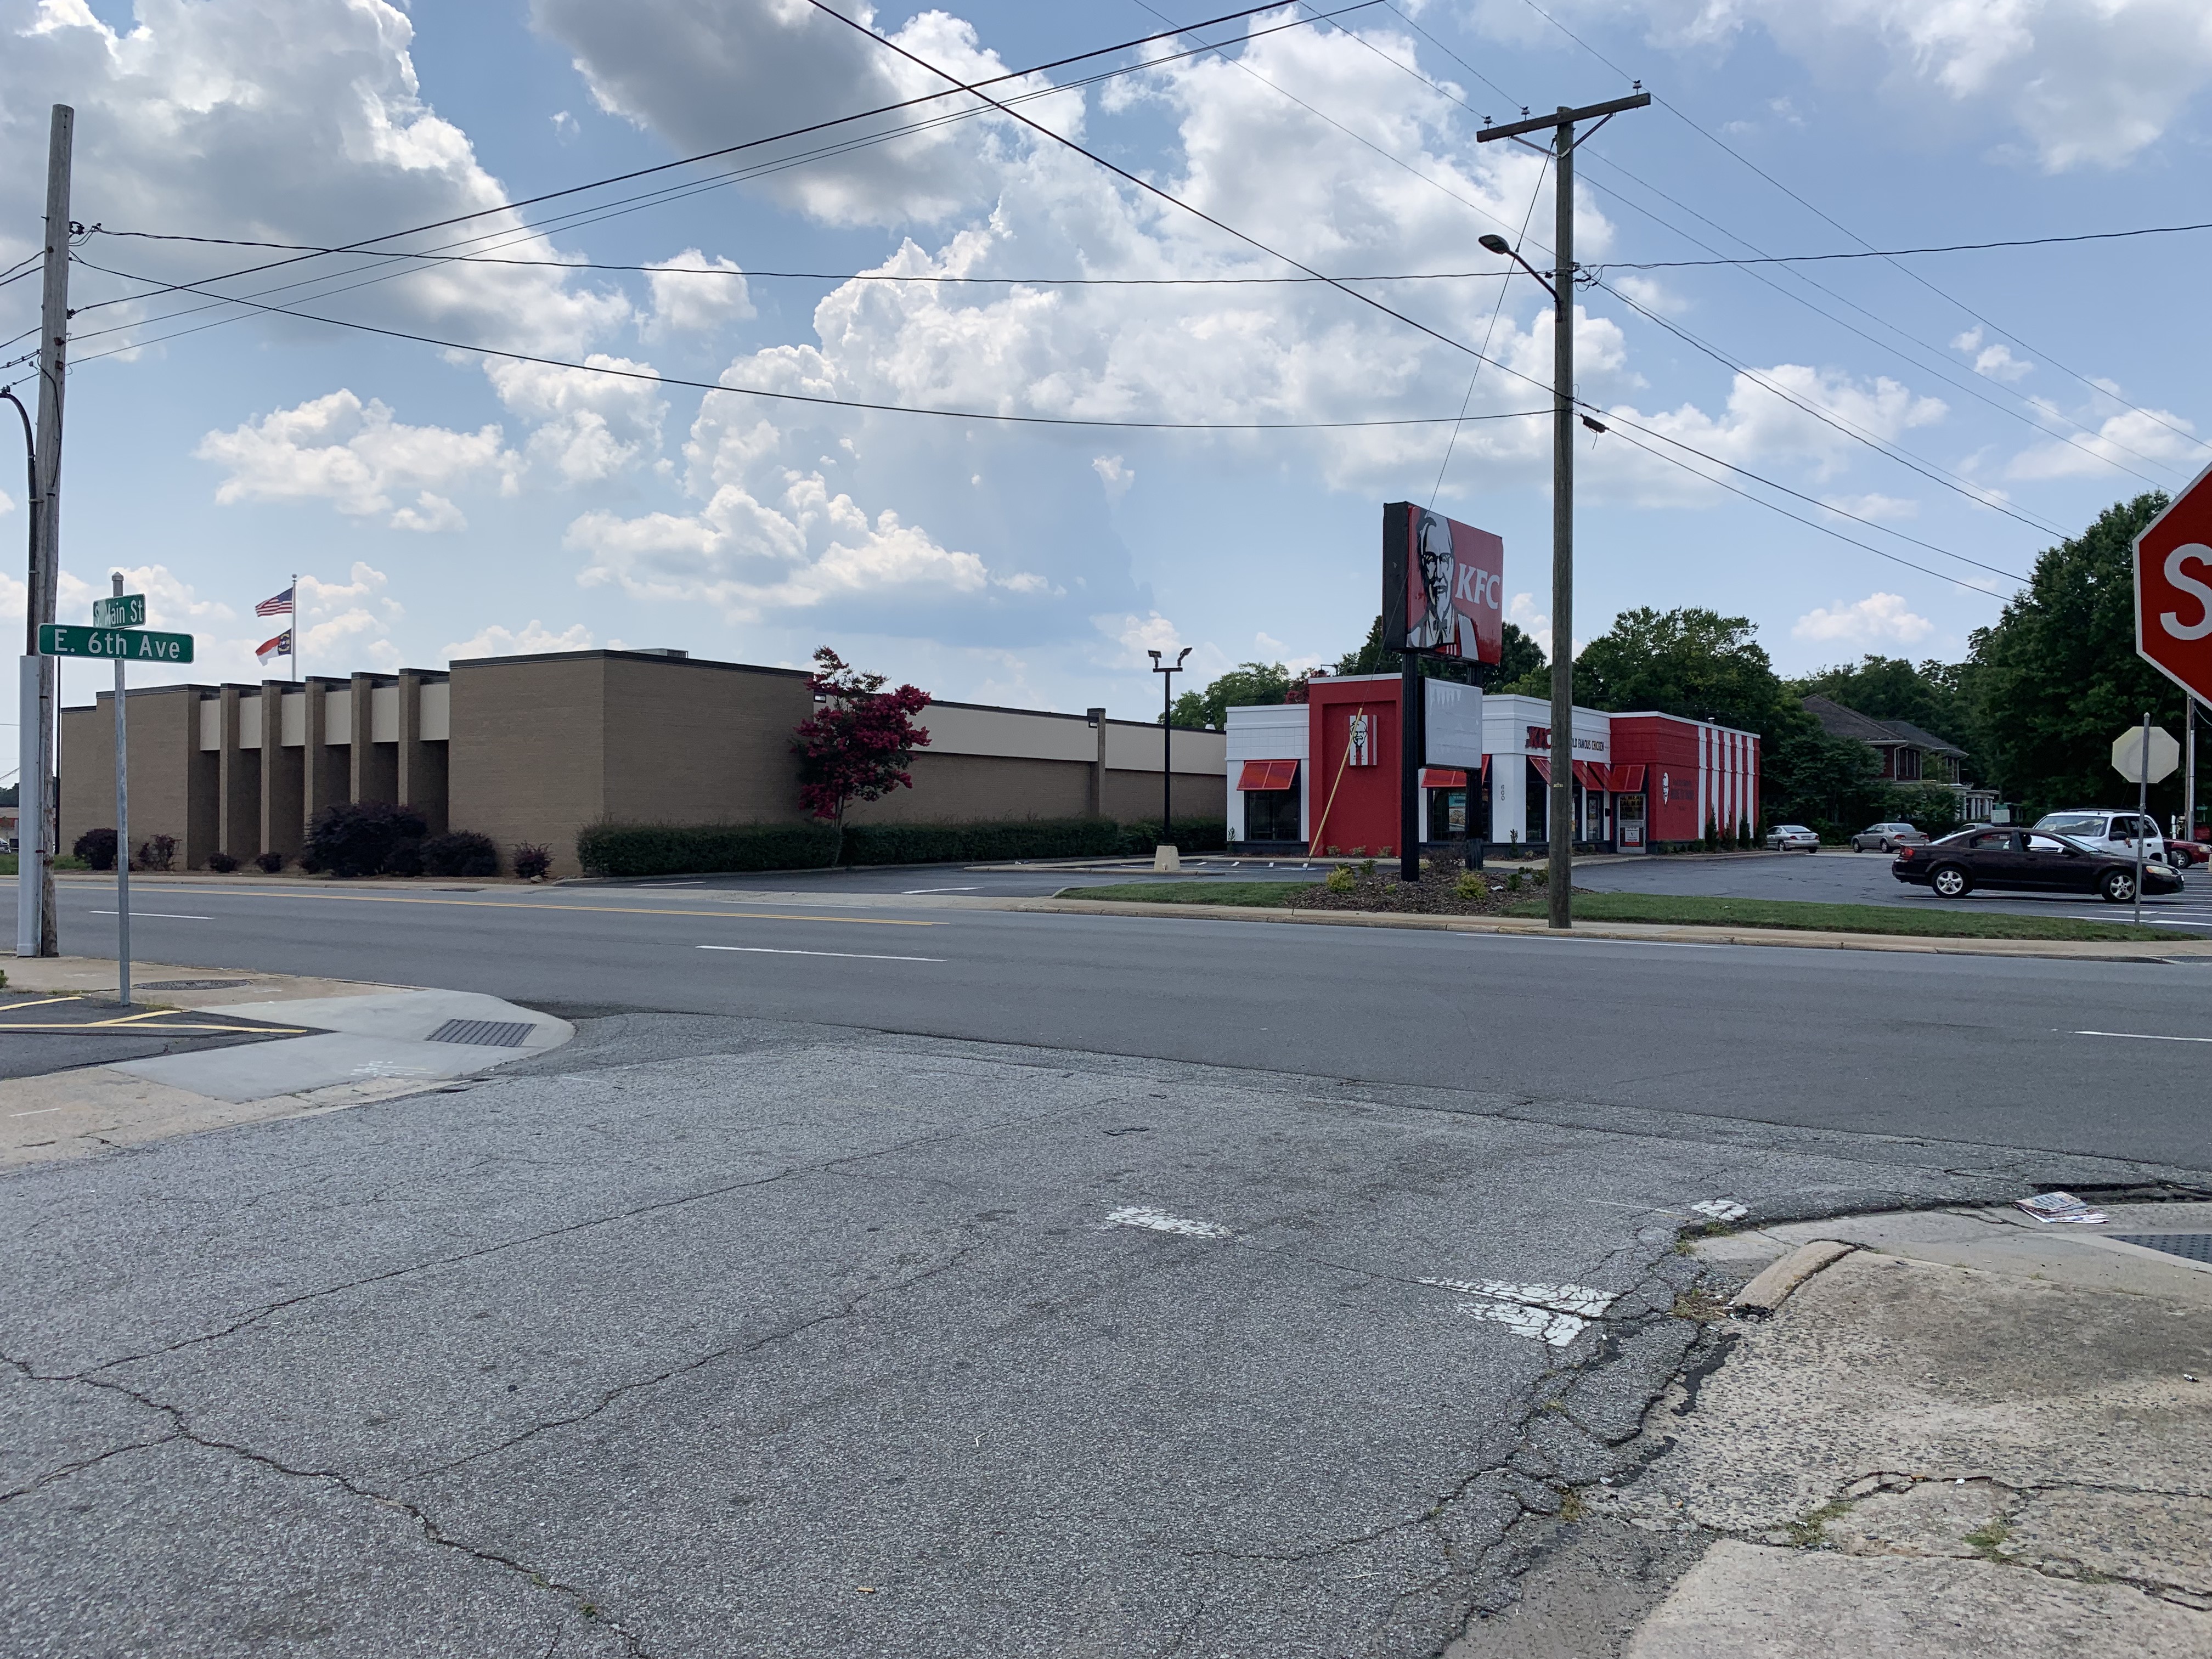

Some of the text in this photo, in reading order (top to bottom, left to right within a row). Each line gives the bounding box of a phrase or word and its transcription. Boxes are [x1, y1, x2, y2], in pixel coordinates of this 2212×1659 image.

[1455, 563, 1500, 610] KFC
[95, 600, 143, 627] S. Main St
[55, 629, 180, 659] E. 6th Ave
